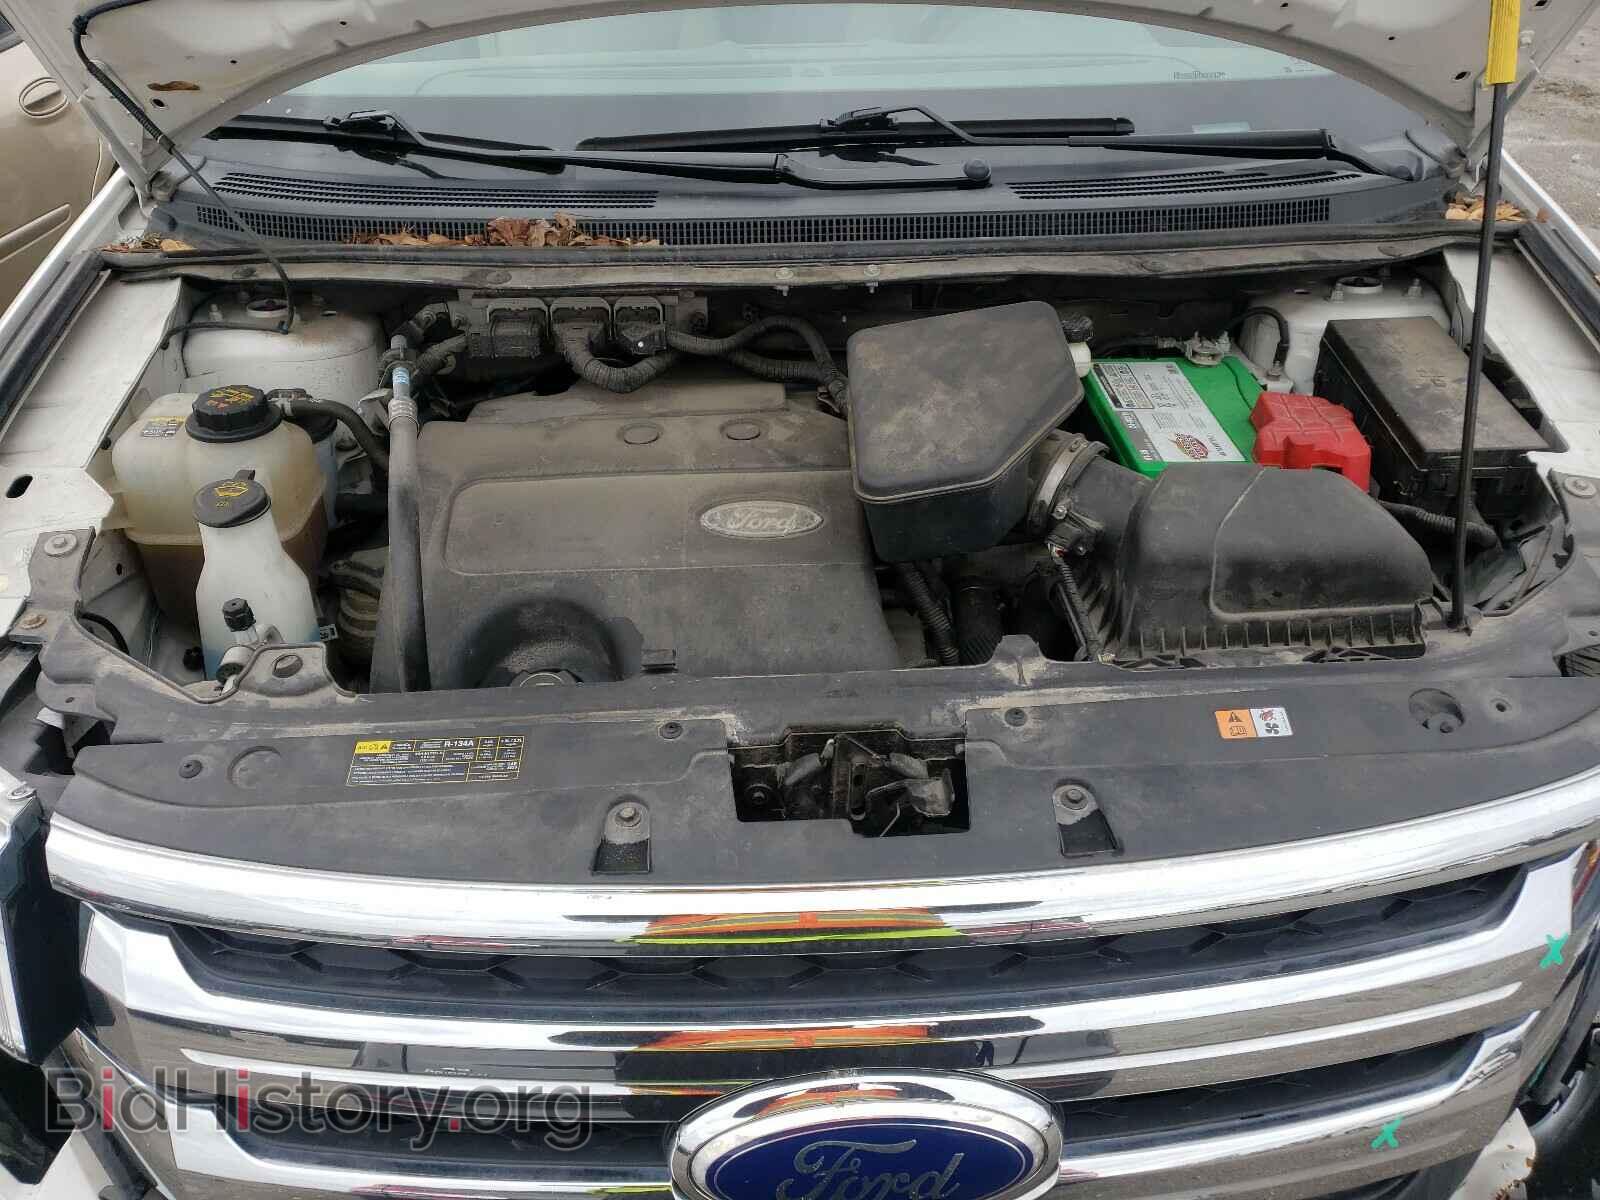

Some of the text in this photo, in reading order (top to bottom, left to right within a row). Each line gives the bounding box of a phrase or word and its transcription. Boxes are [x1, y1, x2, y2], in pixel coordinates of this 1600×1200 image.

[727, 505, 799, 531] Ford
[445, 740, 474, 748] R-134A
[774, 1139, 965, 1200] Ford
